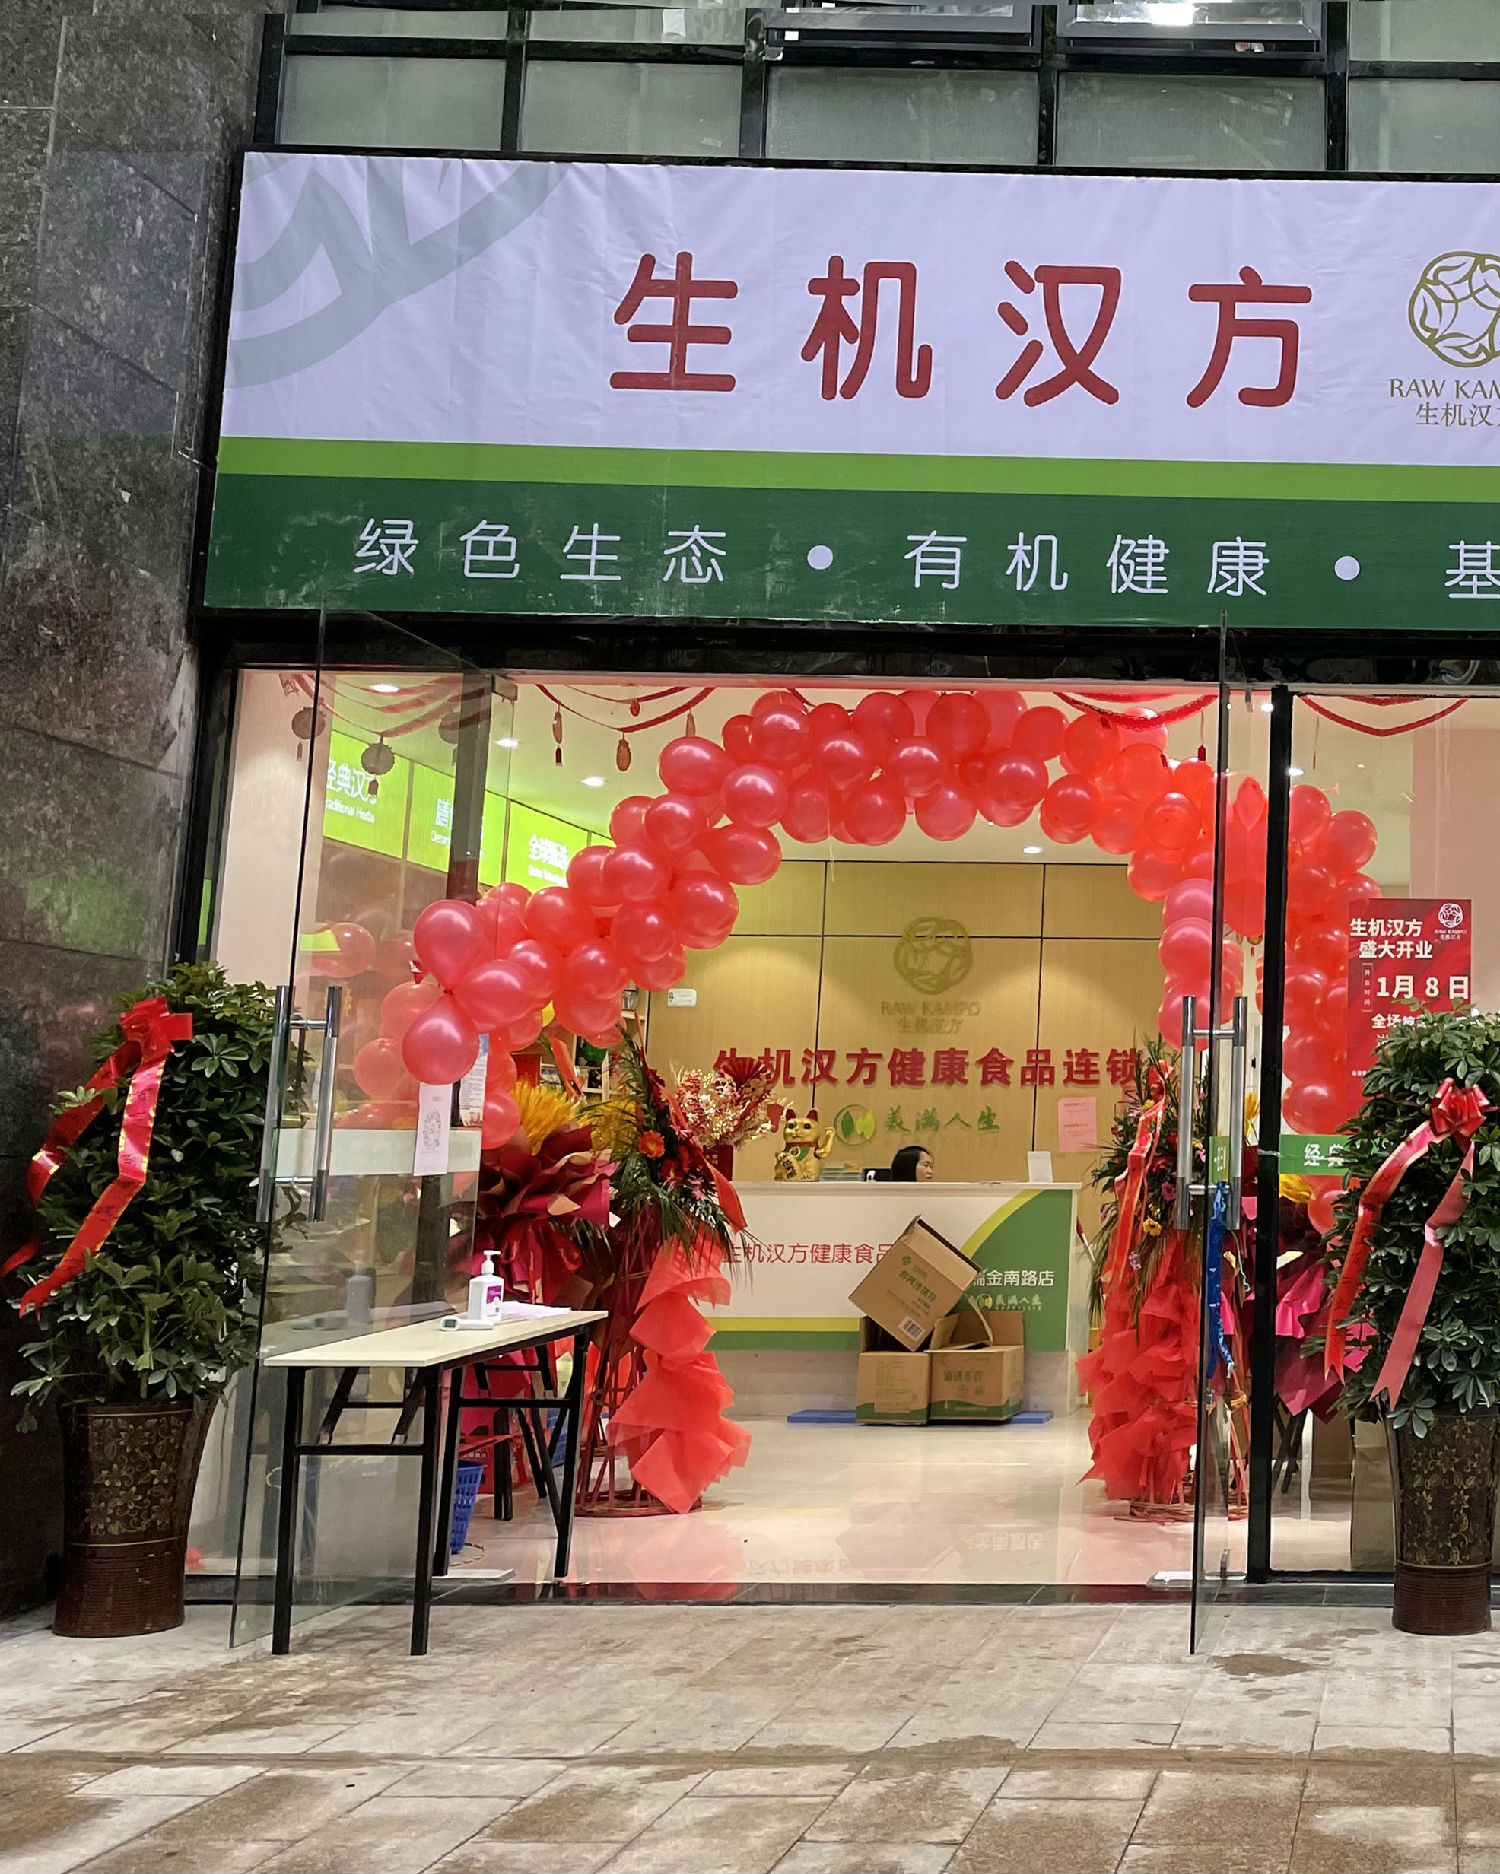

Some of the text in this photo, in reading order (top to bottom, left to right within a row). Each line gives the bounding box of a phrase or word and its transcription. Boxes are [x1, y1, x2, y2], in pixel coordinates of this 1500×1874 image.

[609, 251, 1312, 407] 生机汉方
[1389, 378, 1446, 399] RAW
[354, 518, 727, 584] 绿色生态
[903, 529, 1270, 598] 有机健康
[1350, 918, 1423, 937] 生机汉方
[1358, 940, 1433, 959] 盛大开业
